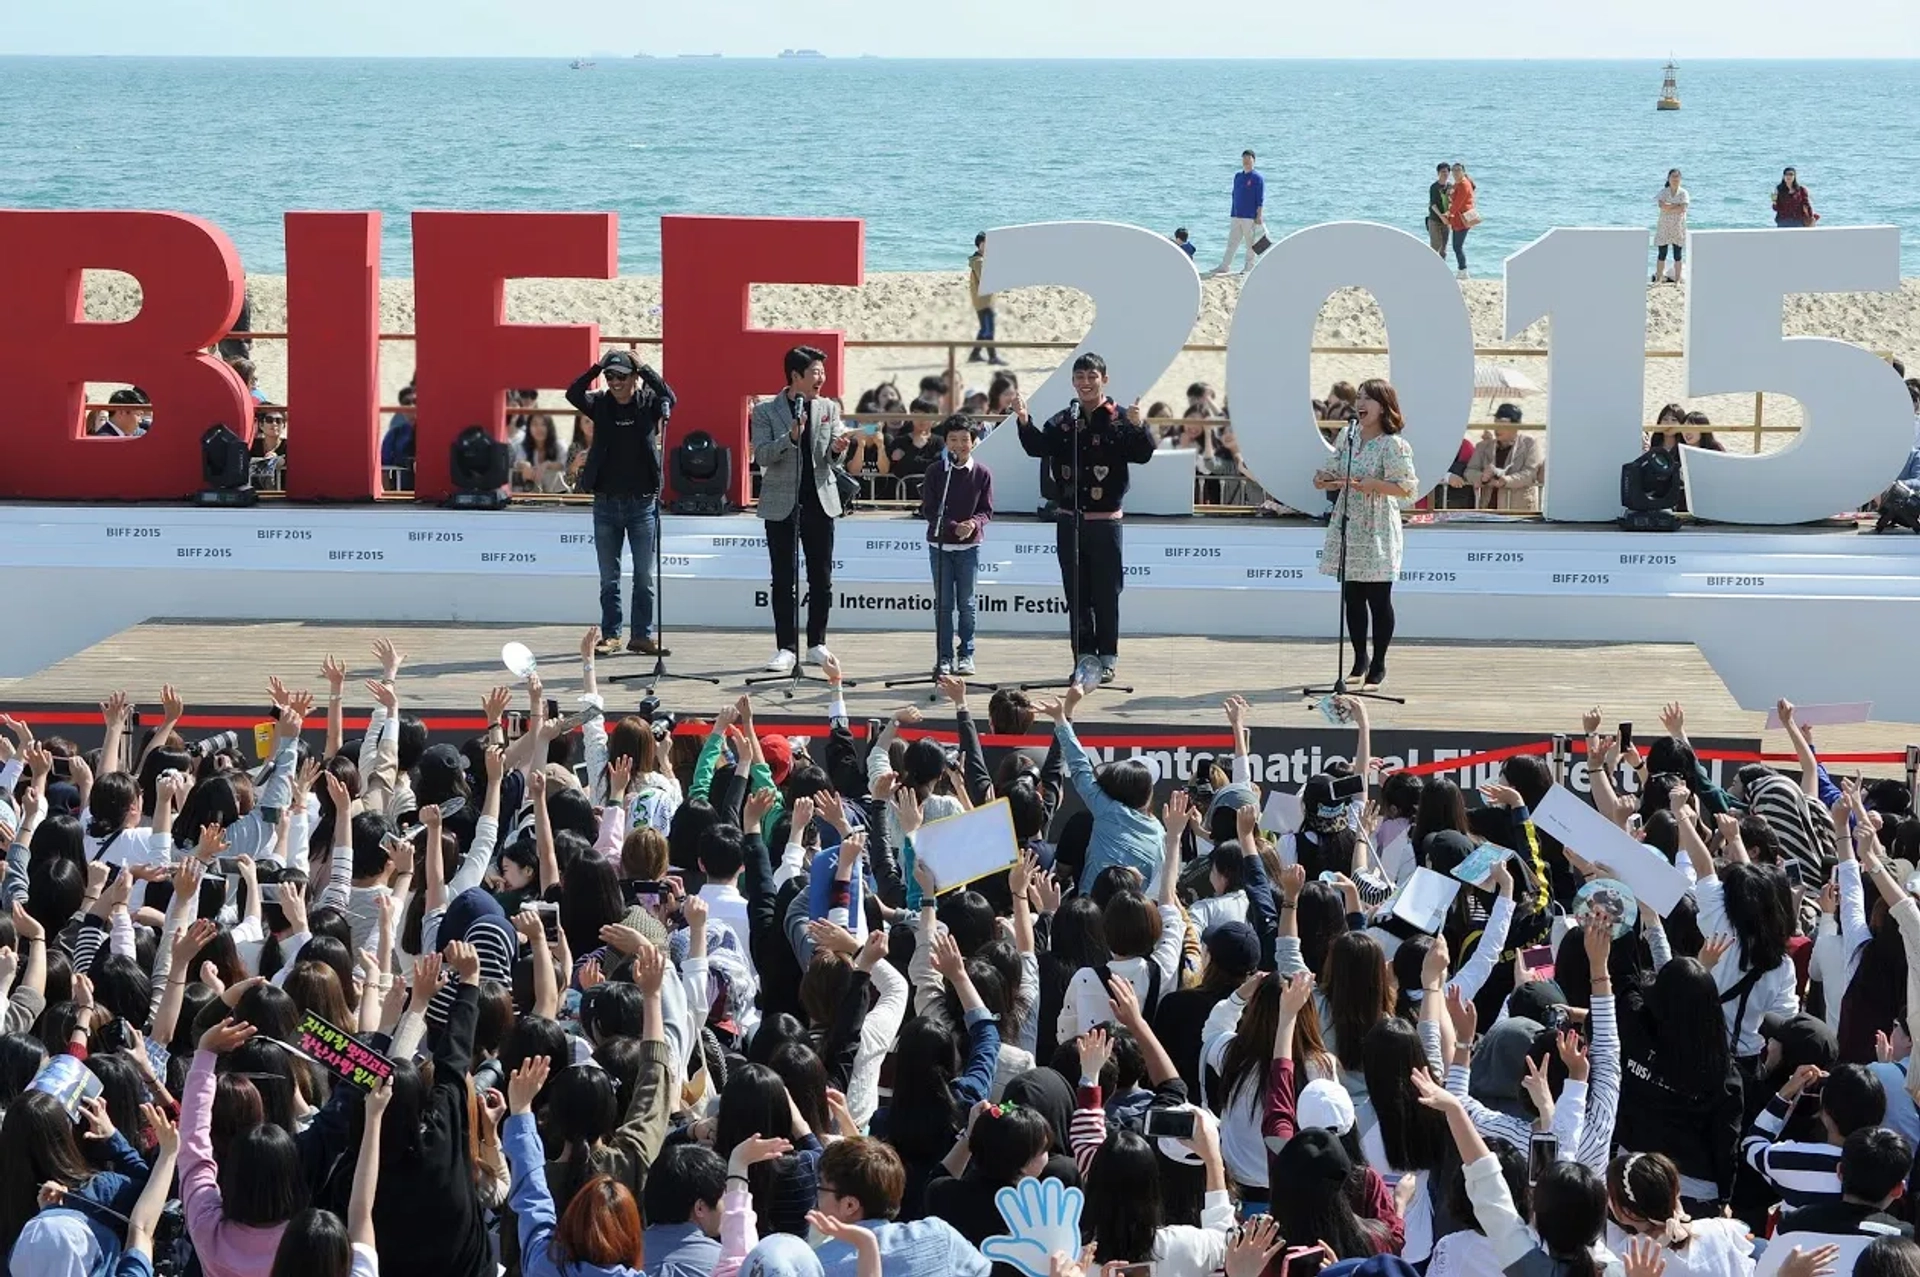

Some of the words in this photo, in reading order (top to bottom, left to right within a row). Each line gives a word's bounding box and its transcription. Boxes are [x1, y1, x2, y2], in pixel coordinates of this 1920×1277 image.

[0, 208, 866, 506] BIFF
[977, 220, 1914, 526] 2015
[975, 594, 1007, 612] ilm
[1014, 595, 1068, 614] Festiv
